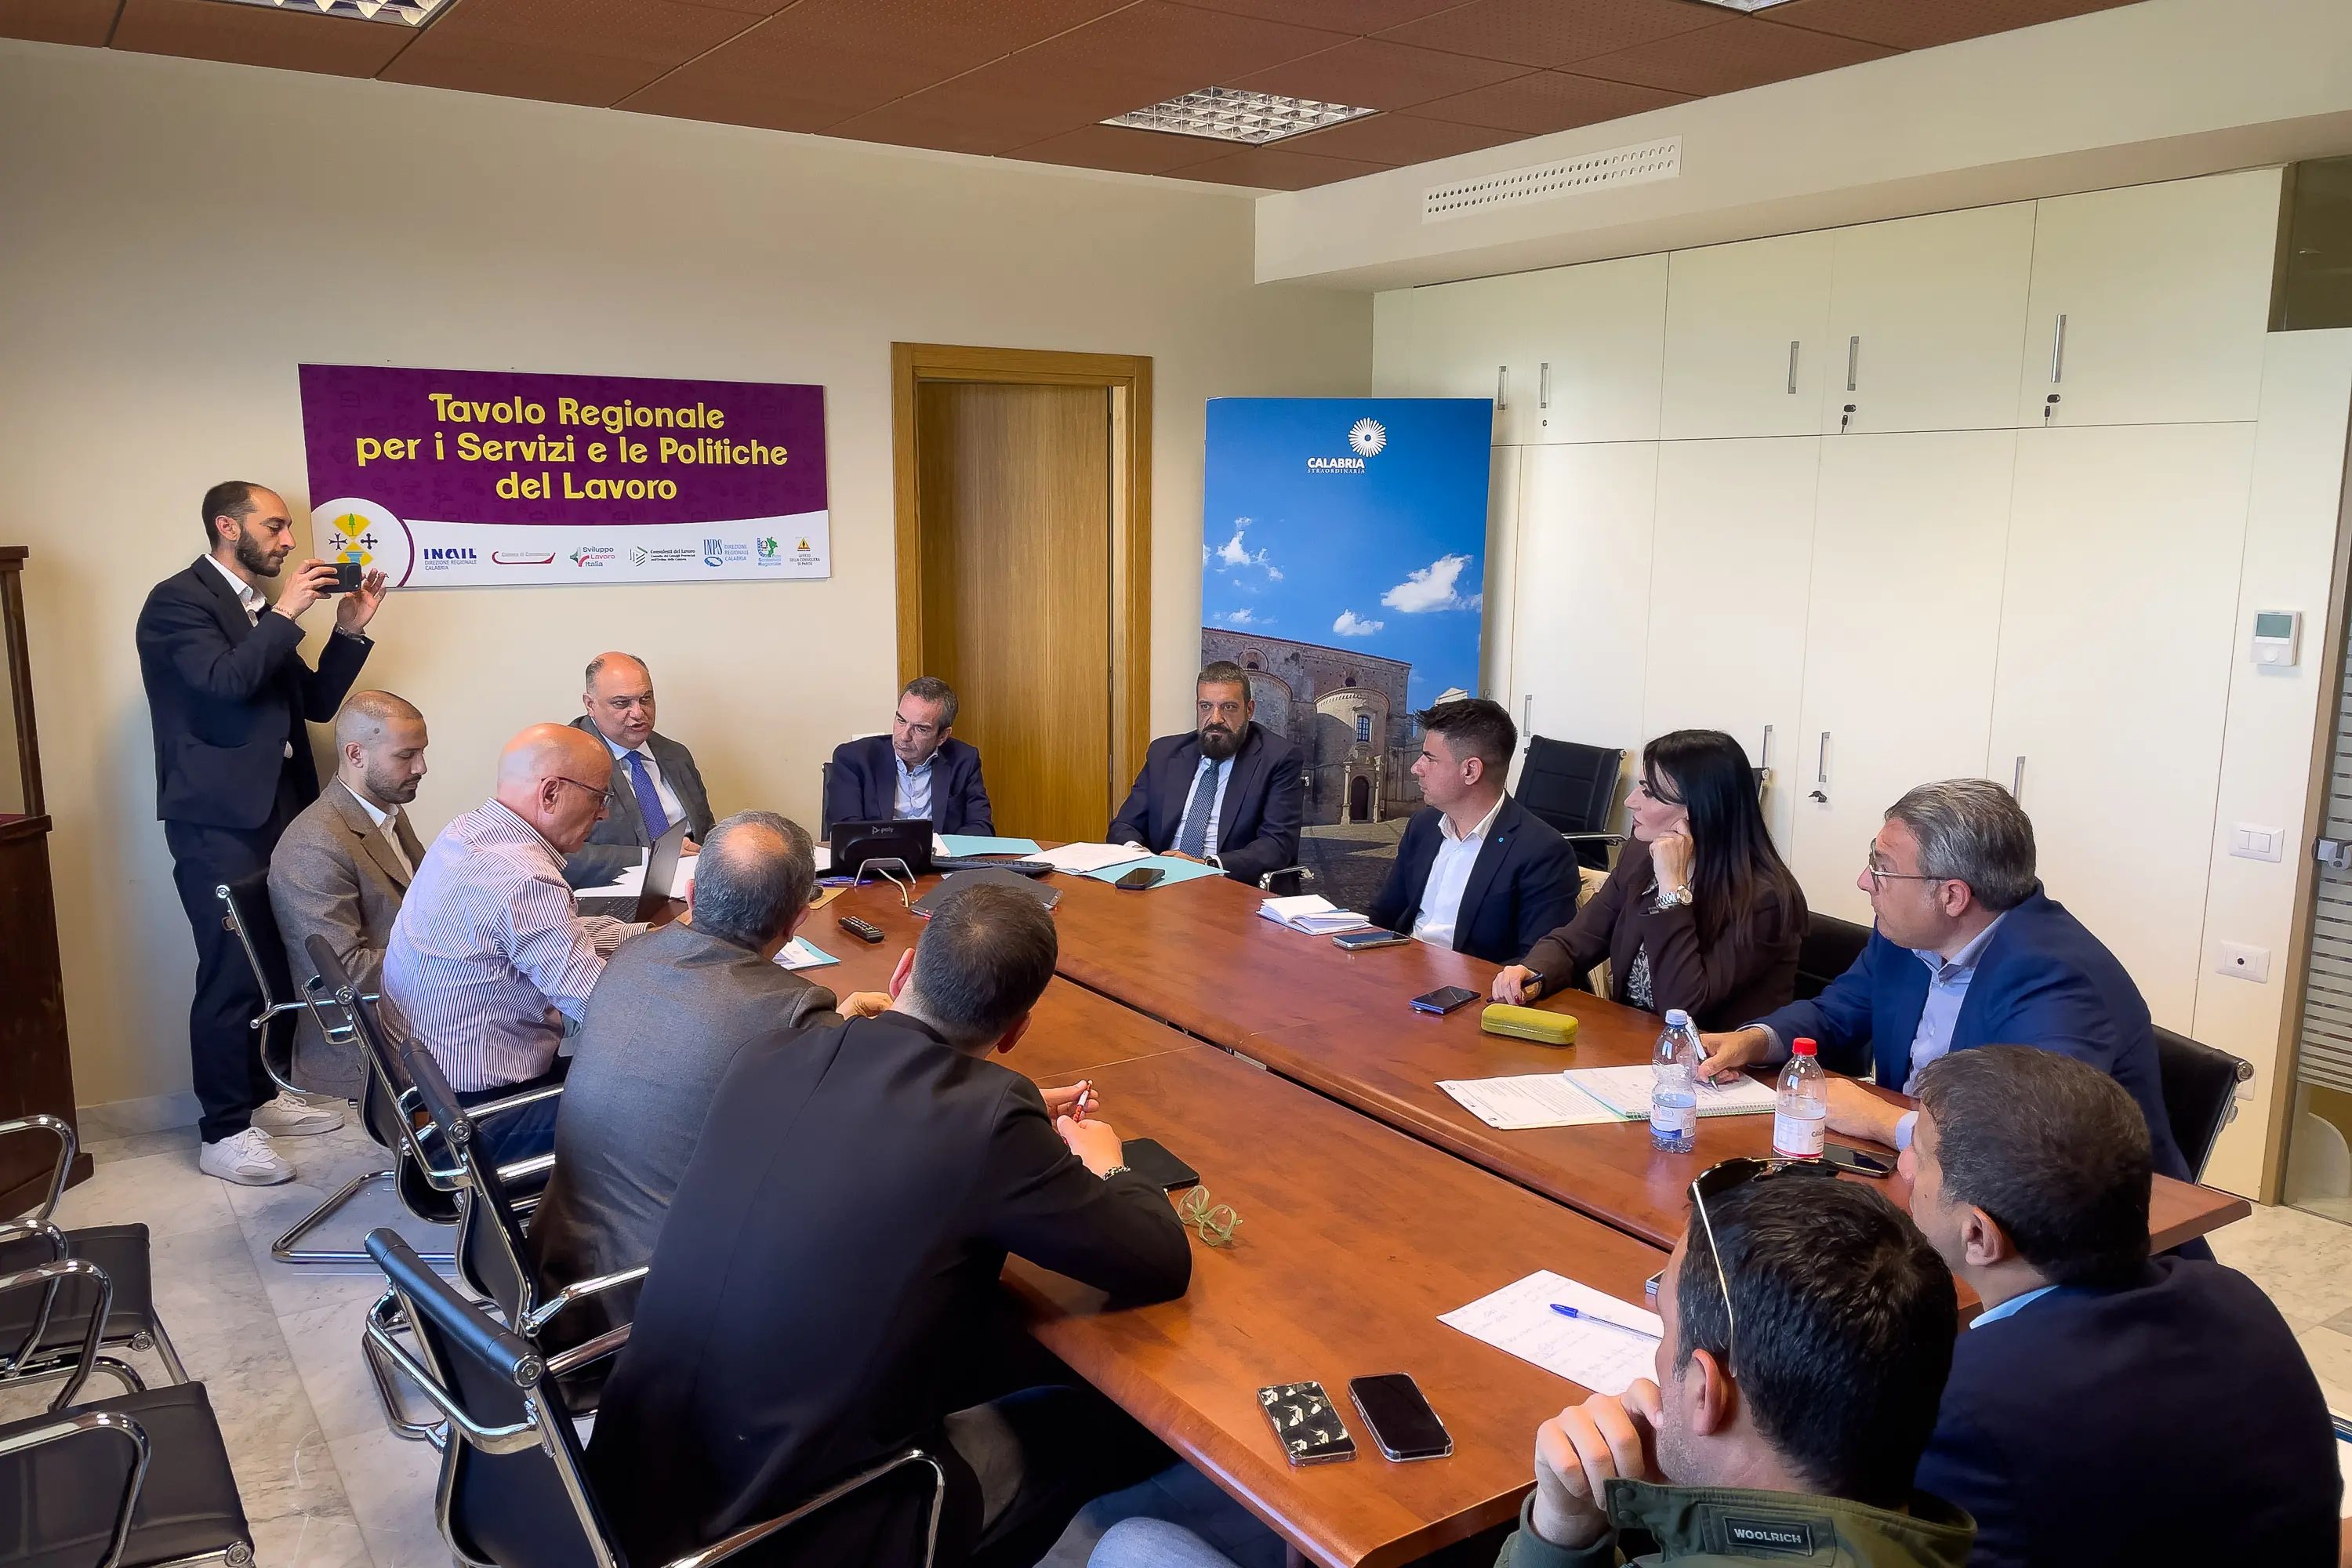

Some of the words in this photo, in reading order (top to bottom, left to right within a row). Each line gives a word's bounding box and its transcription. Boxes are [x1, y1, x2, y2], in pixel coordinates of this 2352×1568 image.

[429, 393, 546, 425] Tavolo
[558, 397, 724, 435] Regionale
[356, 437, 422, 467] per
[434, 431, 445, 460] i
[457, 432, 575, 463] Servizi
[587, 442, 608, 463] e
[619, 436, 648, 463] le
[659, 437, 788, 466] Politiche
[1307, 457, 1365, 469] CALABRIA
[495, 471, 551, 499] del
[563, 472, 677, 500] Lavoro
[423, 548, 477, 559] INAIL
[702, 539, 723, 555] INPS
[1733, 1528, 1802, 1544] WOOLRICH
